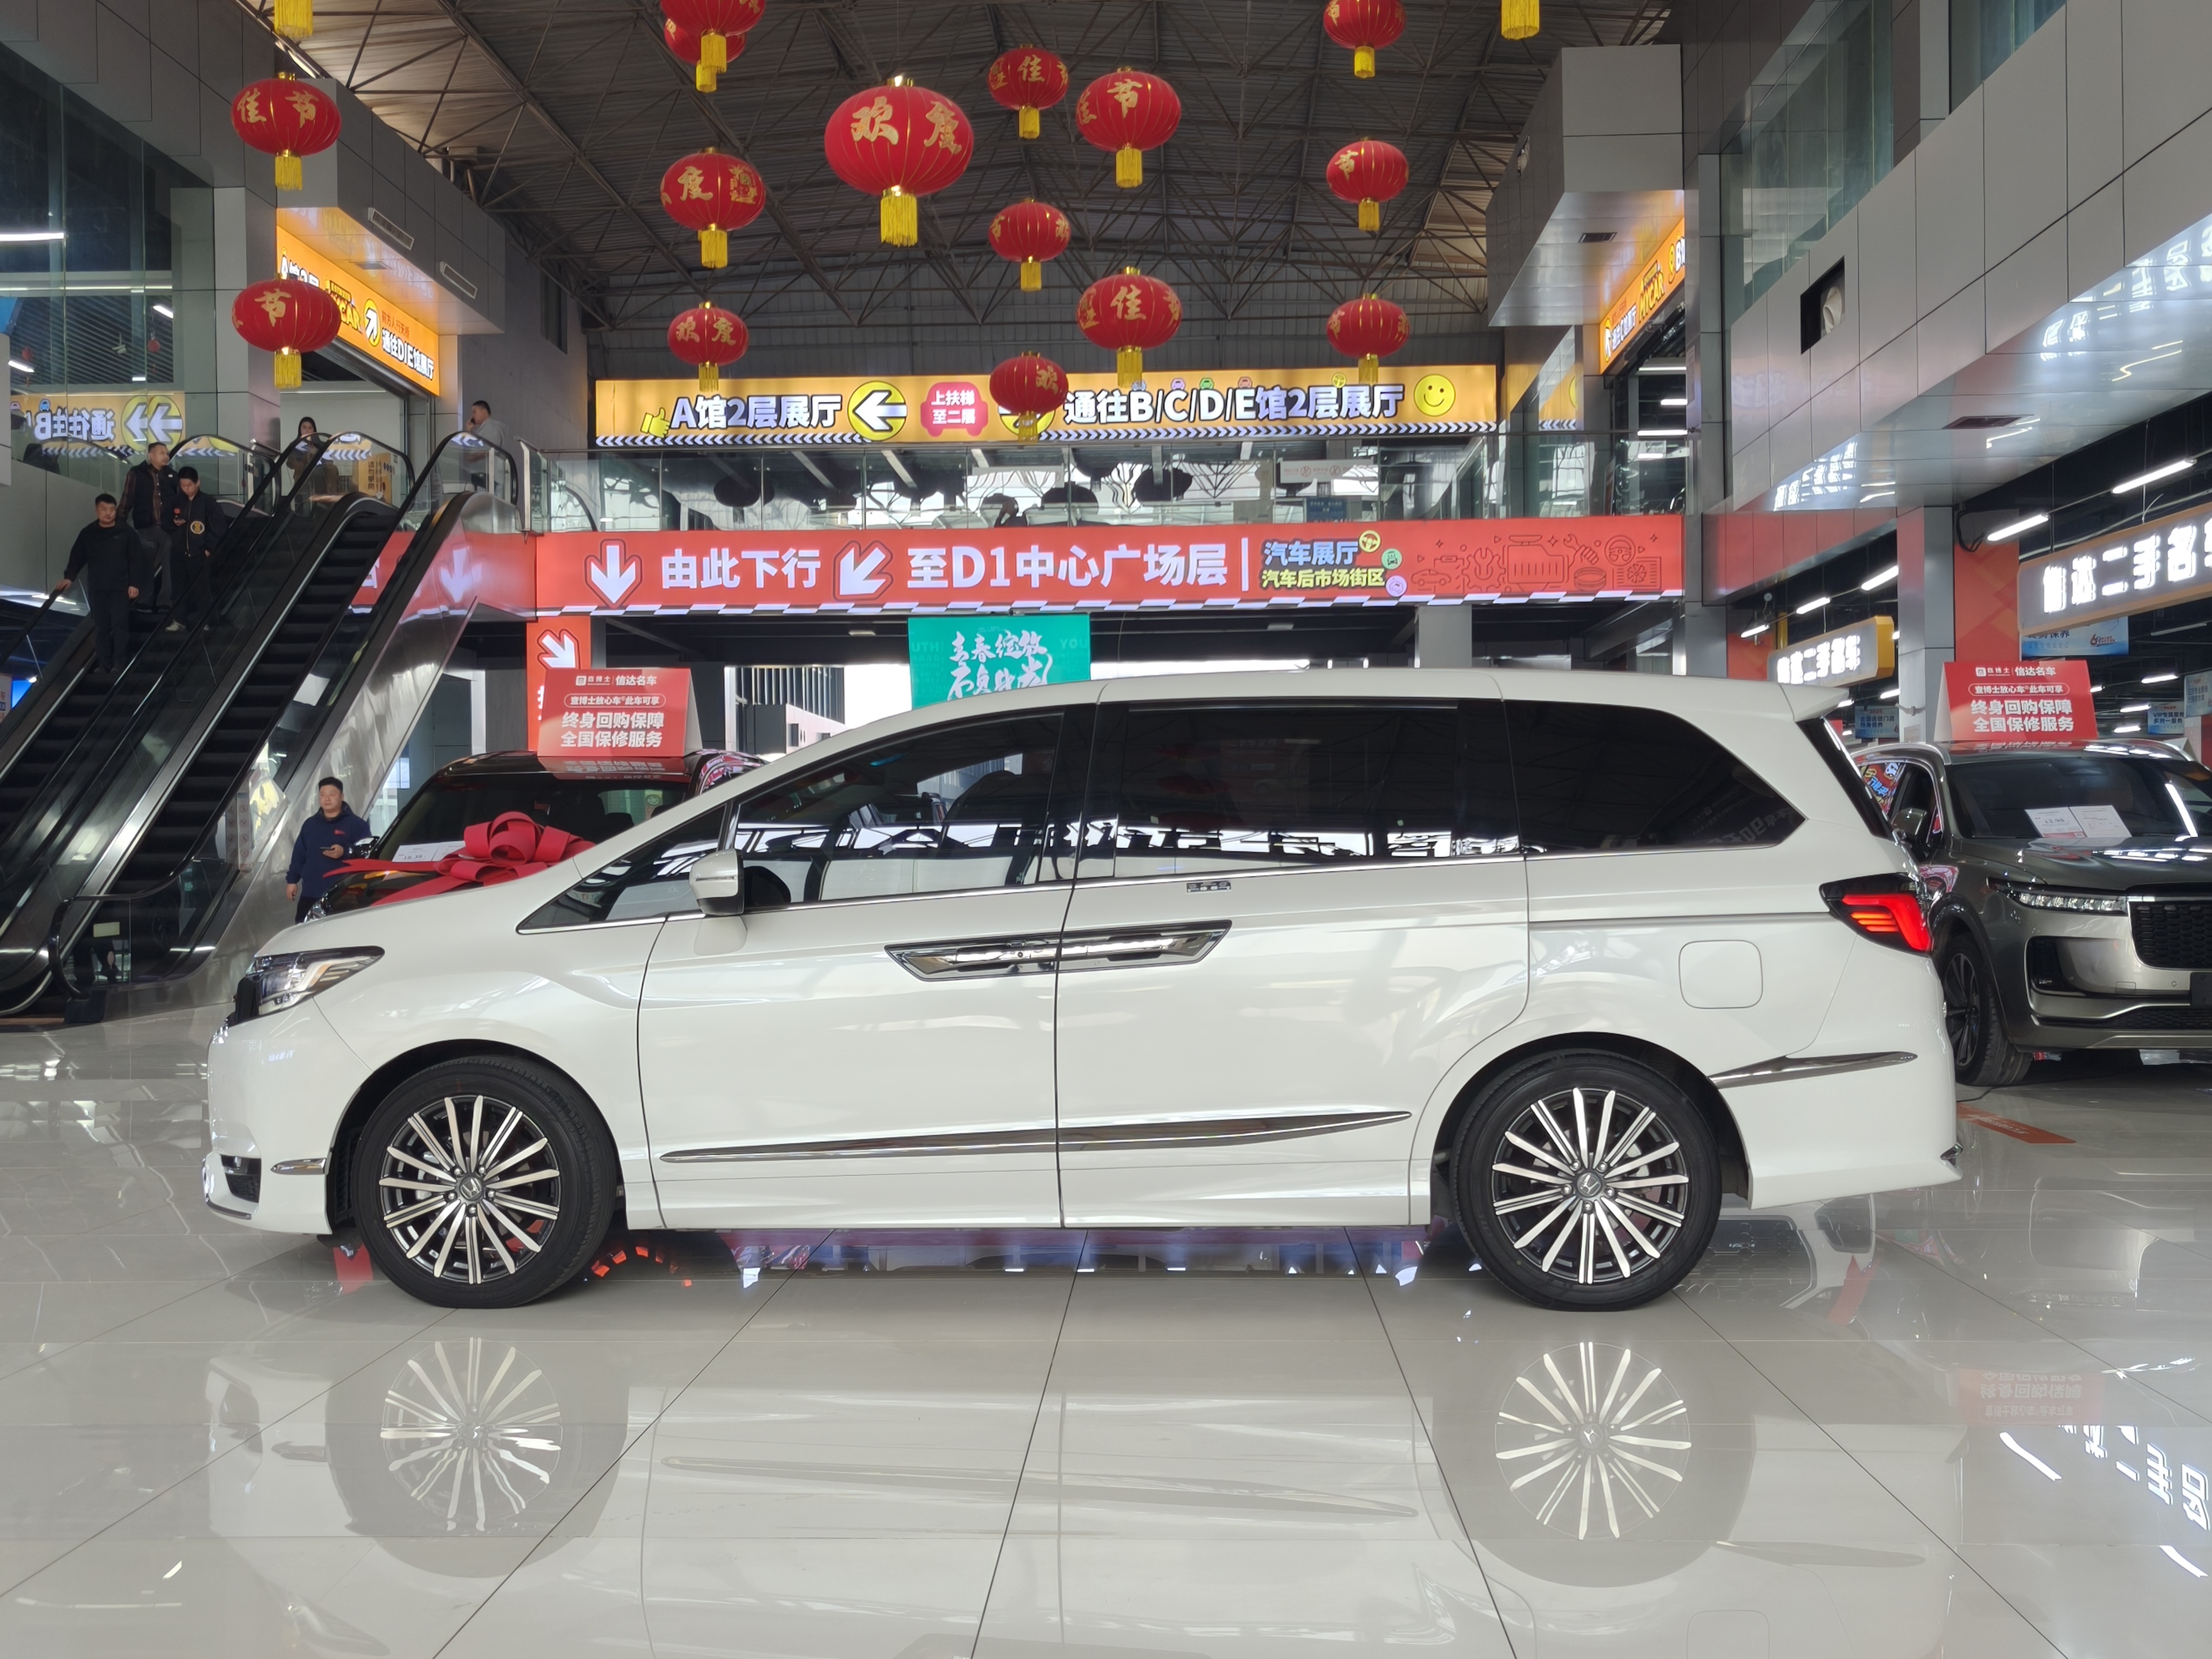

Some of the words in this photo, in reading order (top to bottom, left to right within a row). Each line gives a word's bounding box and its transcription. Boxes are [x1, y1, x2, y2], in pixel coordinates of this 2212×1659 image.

[671, 394, 842, 429] A馆2层展厅
[1064, 384, 1404, 424] 通往B/C/D/E馆2层展厅
[1264, 541, 1358, 566] 汽车展厅
[661, 548, 821, 589] 由此下行
[908, 543, 1228, 589] 至D1中心广场层
[2043, 516, 2212, 614] 信达二手名
[1262, 568, 1385, 588] 汽车后市场街区
[616, 675, 657, 686] 信达名车
[2015, 666, 2056, 676] 信达名车
[1971, 699, 2073, 715] 终身回购保障
[562, 711, 664, 729] 终身回购保障
[1973, 716, 2074, 732] 全国保修服务
[561, 731, 663, 747] 全国保修服务
